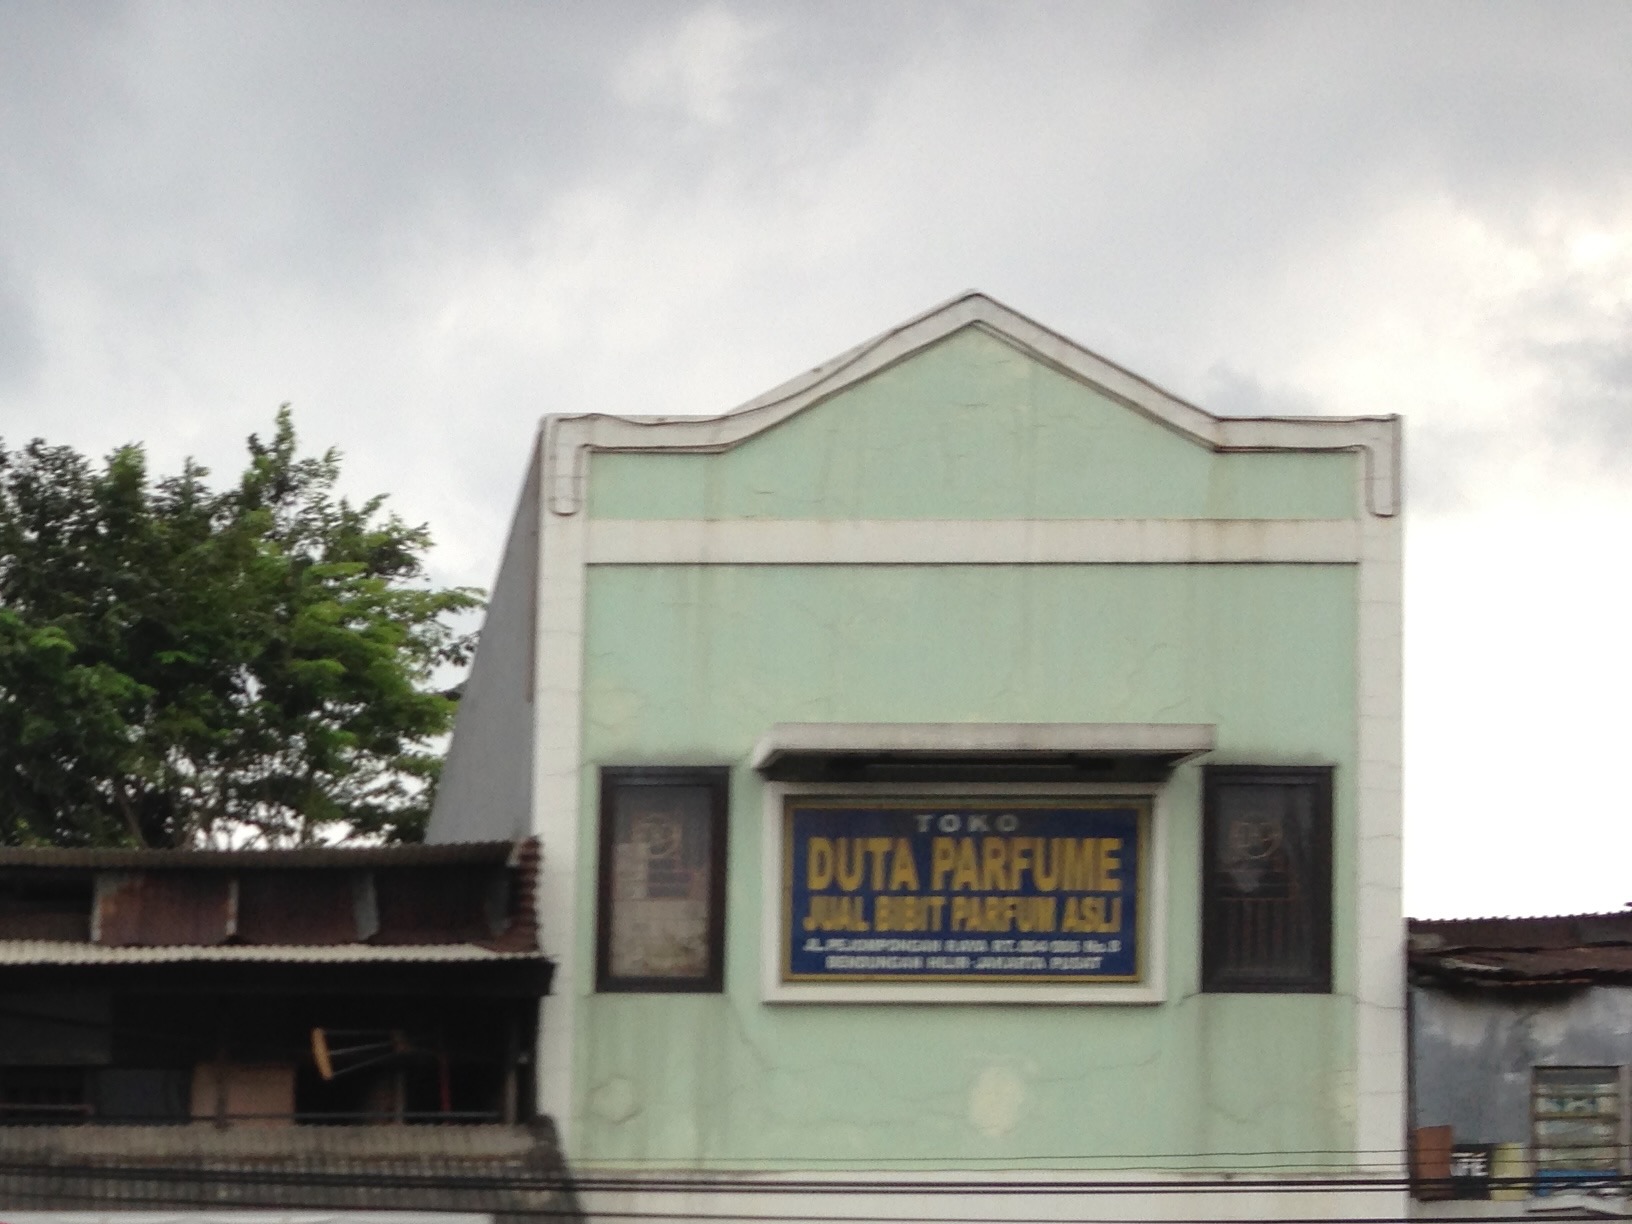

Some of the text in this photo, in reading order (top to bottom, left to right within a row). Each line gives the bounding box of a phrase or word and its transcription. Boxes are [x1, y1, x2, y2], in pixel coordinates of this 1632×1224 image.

[915, 814, 1020, 832] TOKO
[806, 837, 1123, 892] DUTA PARFUME
[803, 896, 1122, 932] JUAL BIBIT PARFUM ASLI
